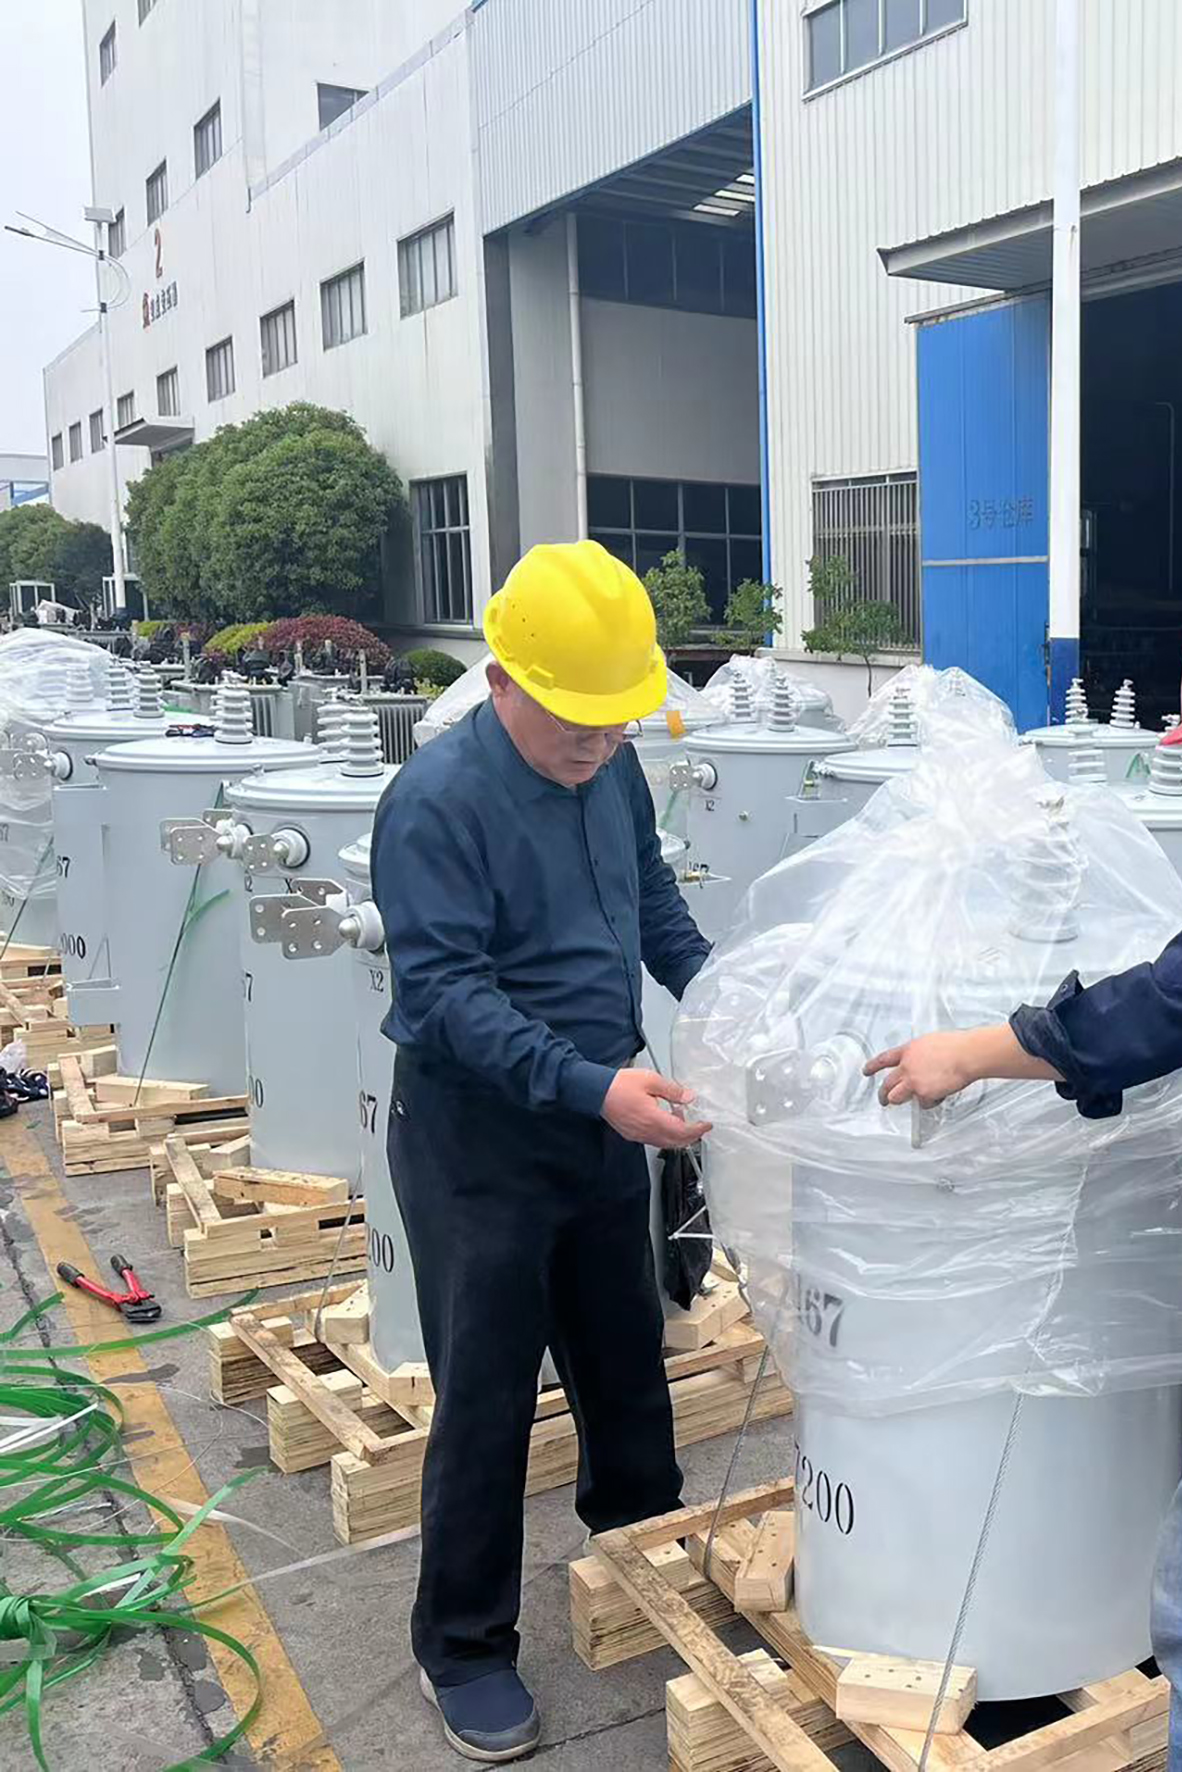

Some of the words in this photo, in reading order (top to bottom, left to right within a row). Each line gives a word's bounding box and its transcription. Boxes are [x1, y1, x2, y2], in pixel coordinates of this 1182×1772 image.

[966, 497, 1034, 531] 3号仓库
[369, 969, 385, 993] X2
